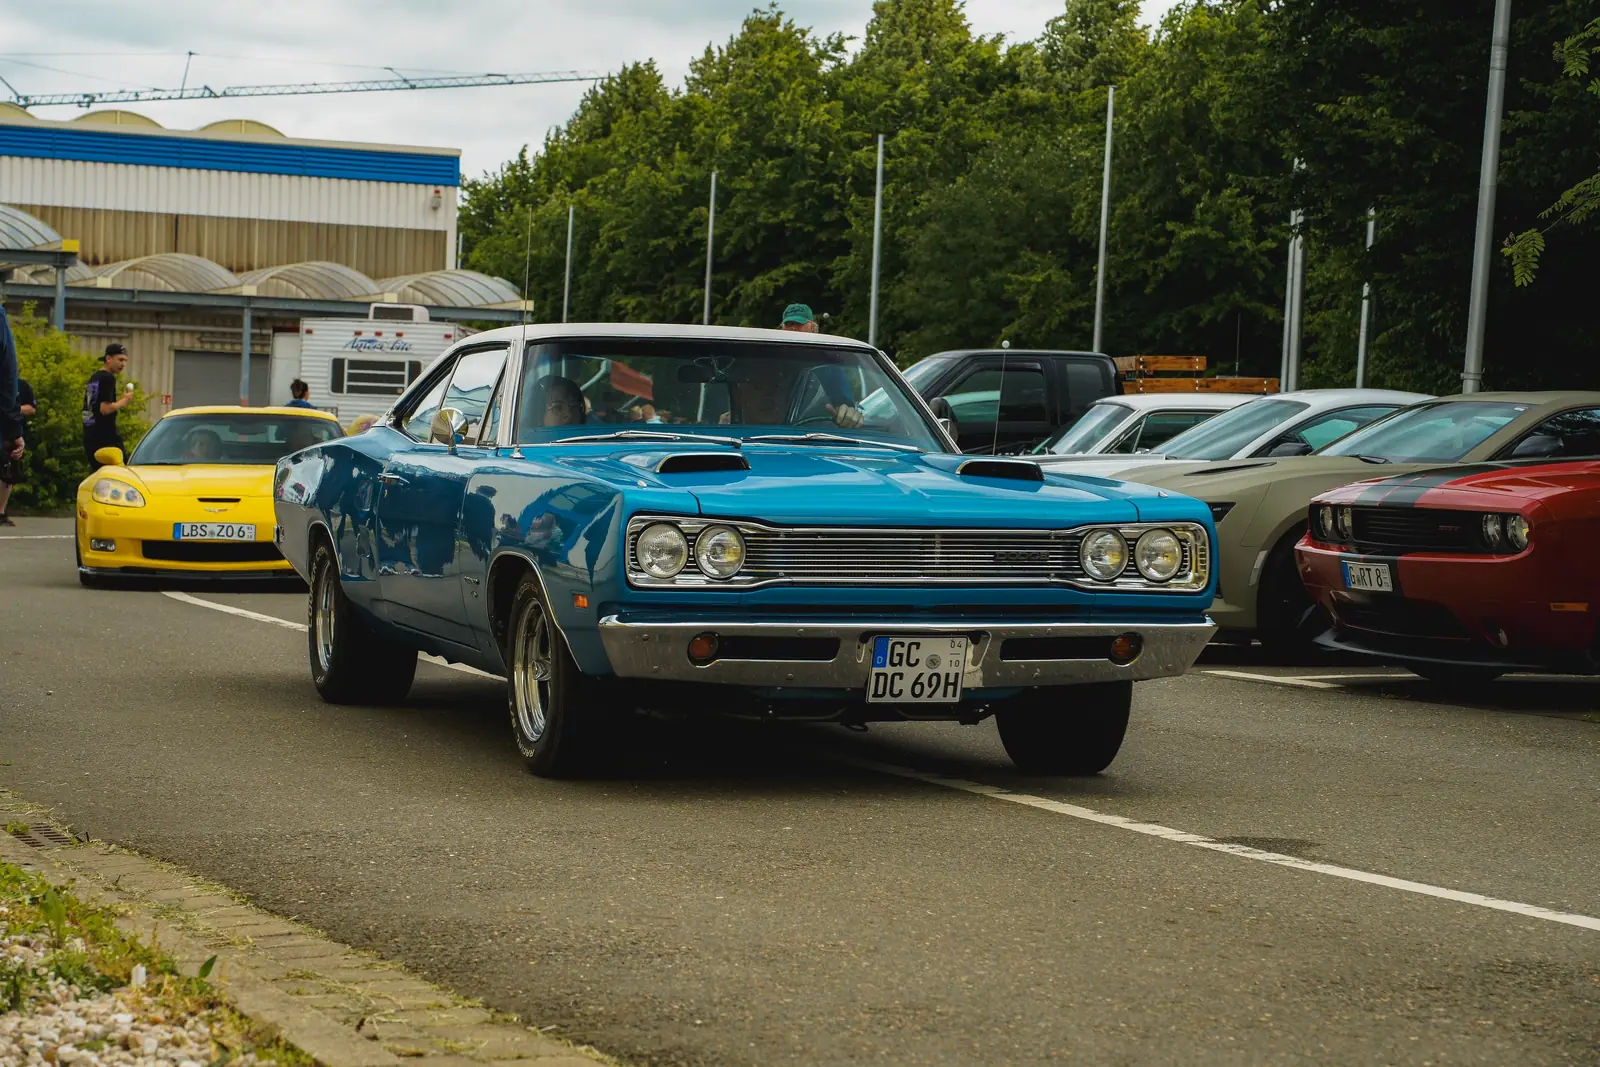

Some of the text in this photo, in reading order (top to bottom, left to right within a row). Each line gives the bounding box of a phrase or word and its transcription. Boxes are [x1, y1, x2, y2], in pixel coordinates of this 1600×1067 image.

[181, 524, 208, 537] LBS
[237, 526, 246, 538] 6
[995, 551, 1050, 560] DODGE
[1349, 566, 1383, 587] G RT 8
[950, 640, 962, 648] 04
[876, 656, 883, 664] D
[889, 641, 921, 667] GC
[872, 672, 960, 698] DC 69H
